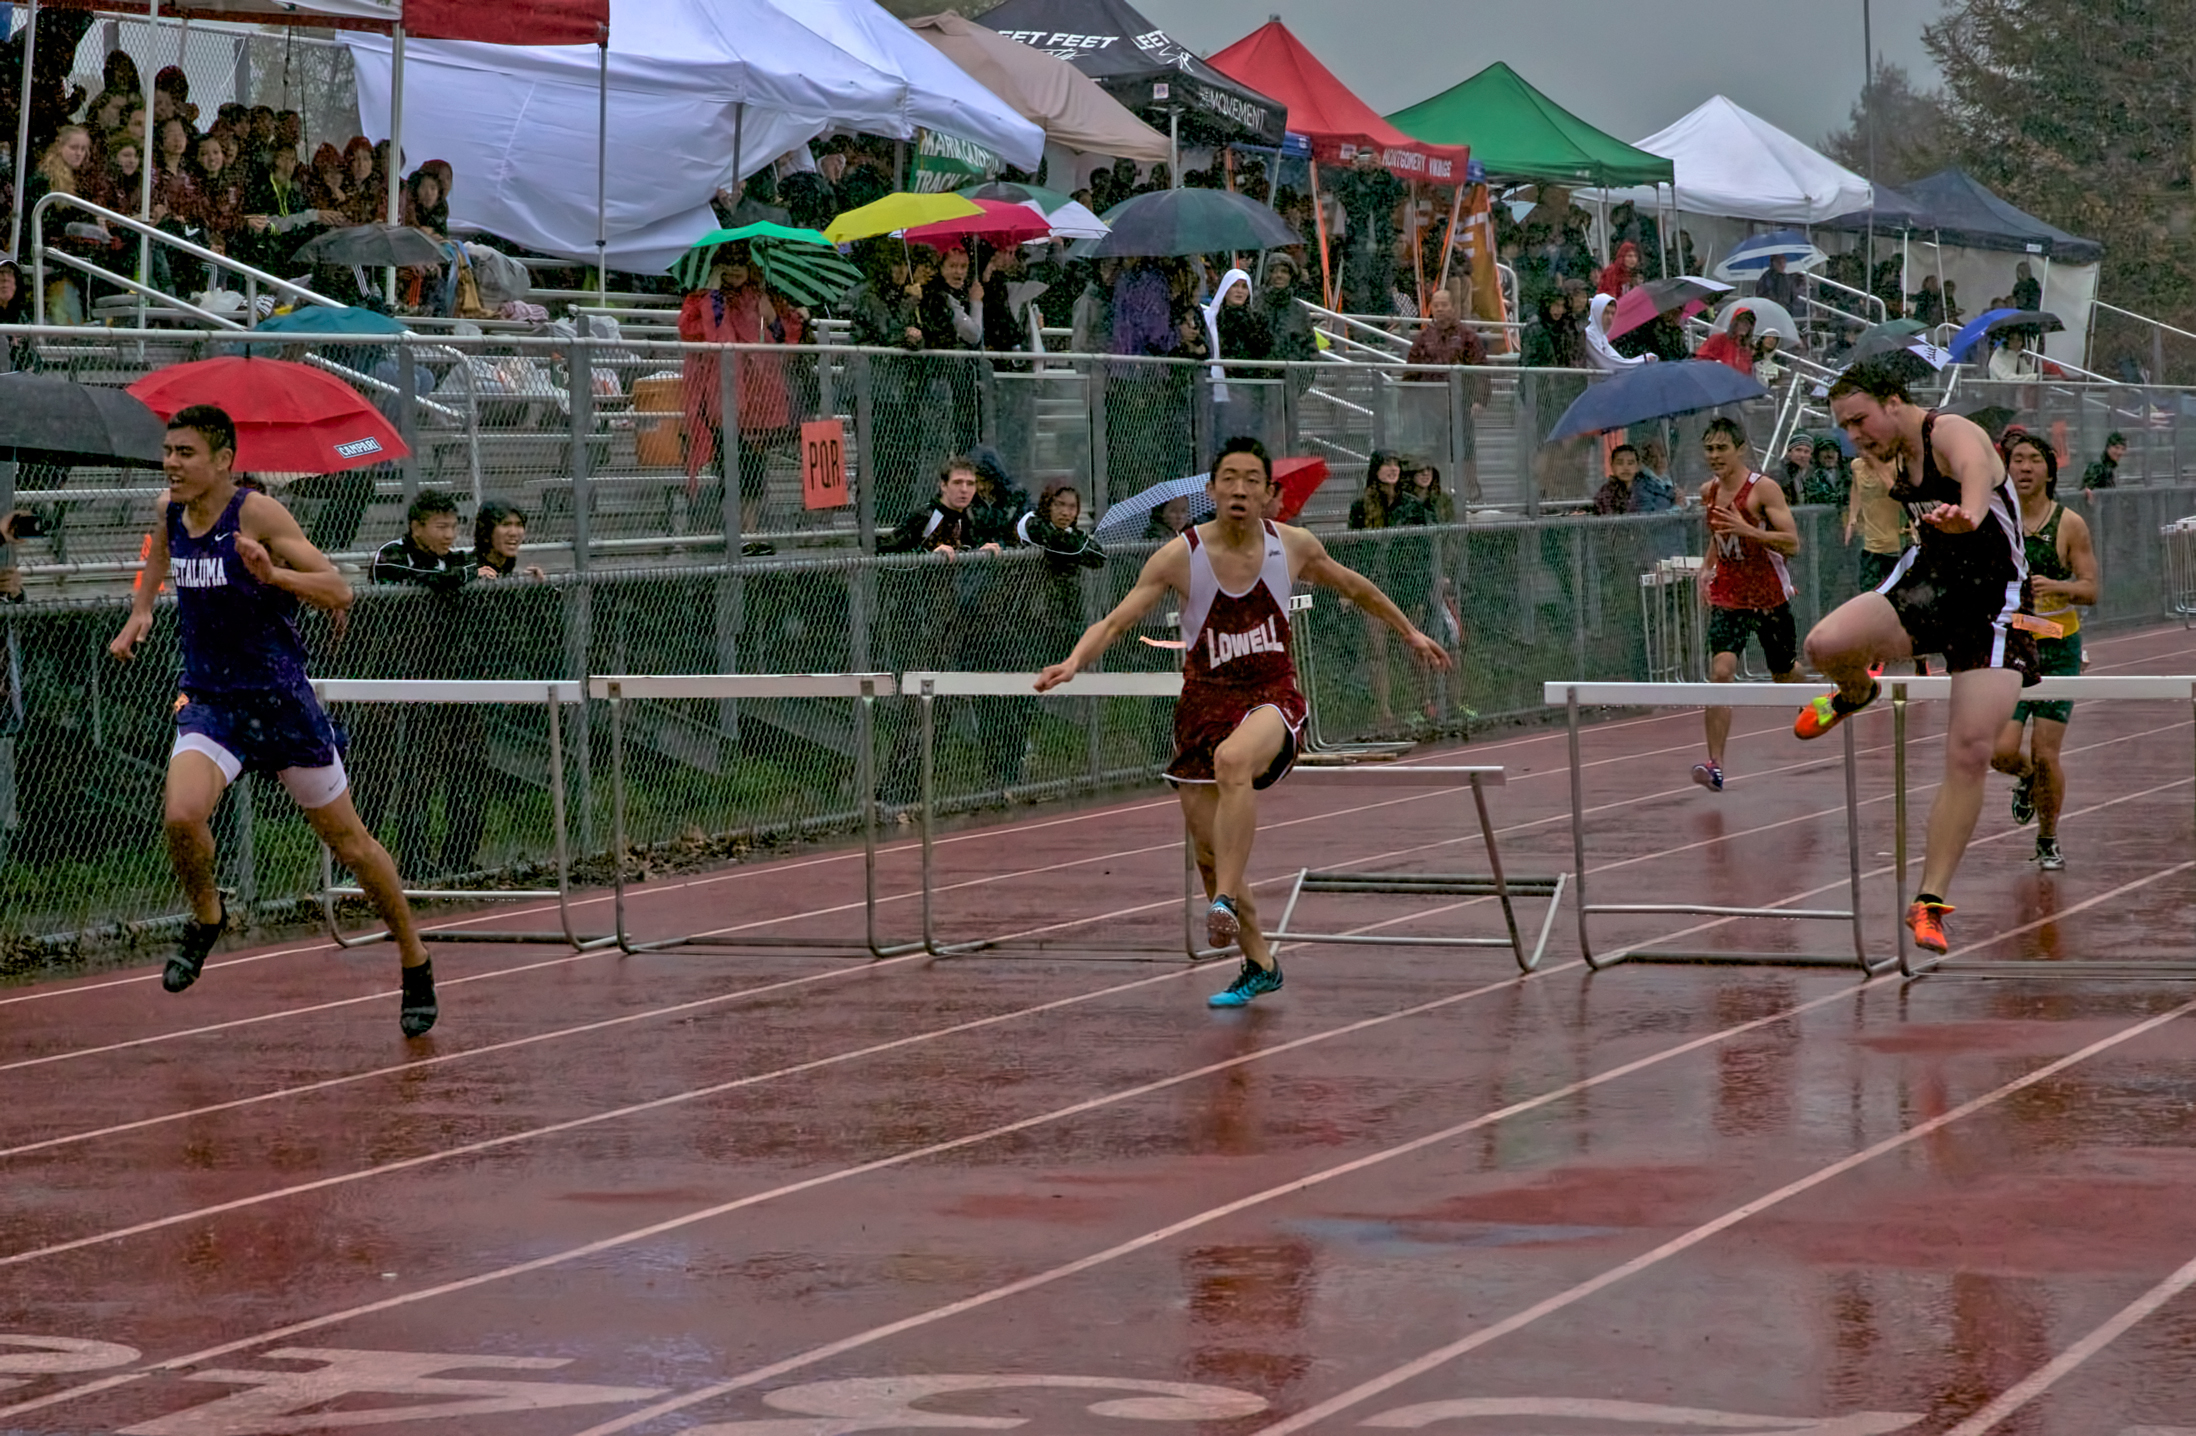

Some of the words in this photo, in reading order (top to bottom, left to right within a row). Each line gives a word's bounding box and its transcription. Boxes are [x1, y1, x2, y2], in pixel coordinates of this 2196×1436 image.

[1046, 32, 1120, 49] FEET
[1210, 90, 1268, 132] MOVEMENT
[1382, 148, 1427, 173] MONTGOMERY
[1429, 157, 1452, 178] VIKINGS
[914, 169, 961, 194] TRACK
[338, 439, 379, 456] CAMPARI
[809, 439, 840, 490] PQR
[1206, 614, 1285, 670] LOWELL
